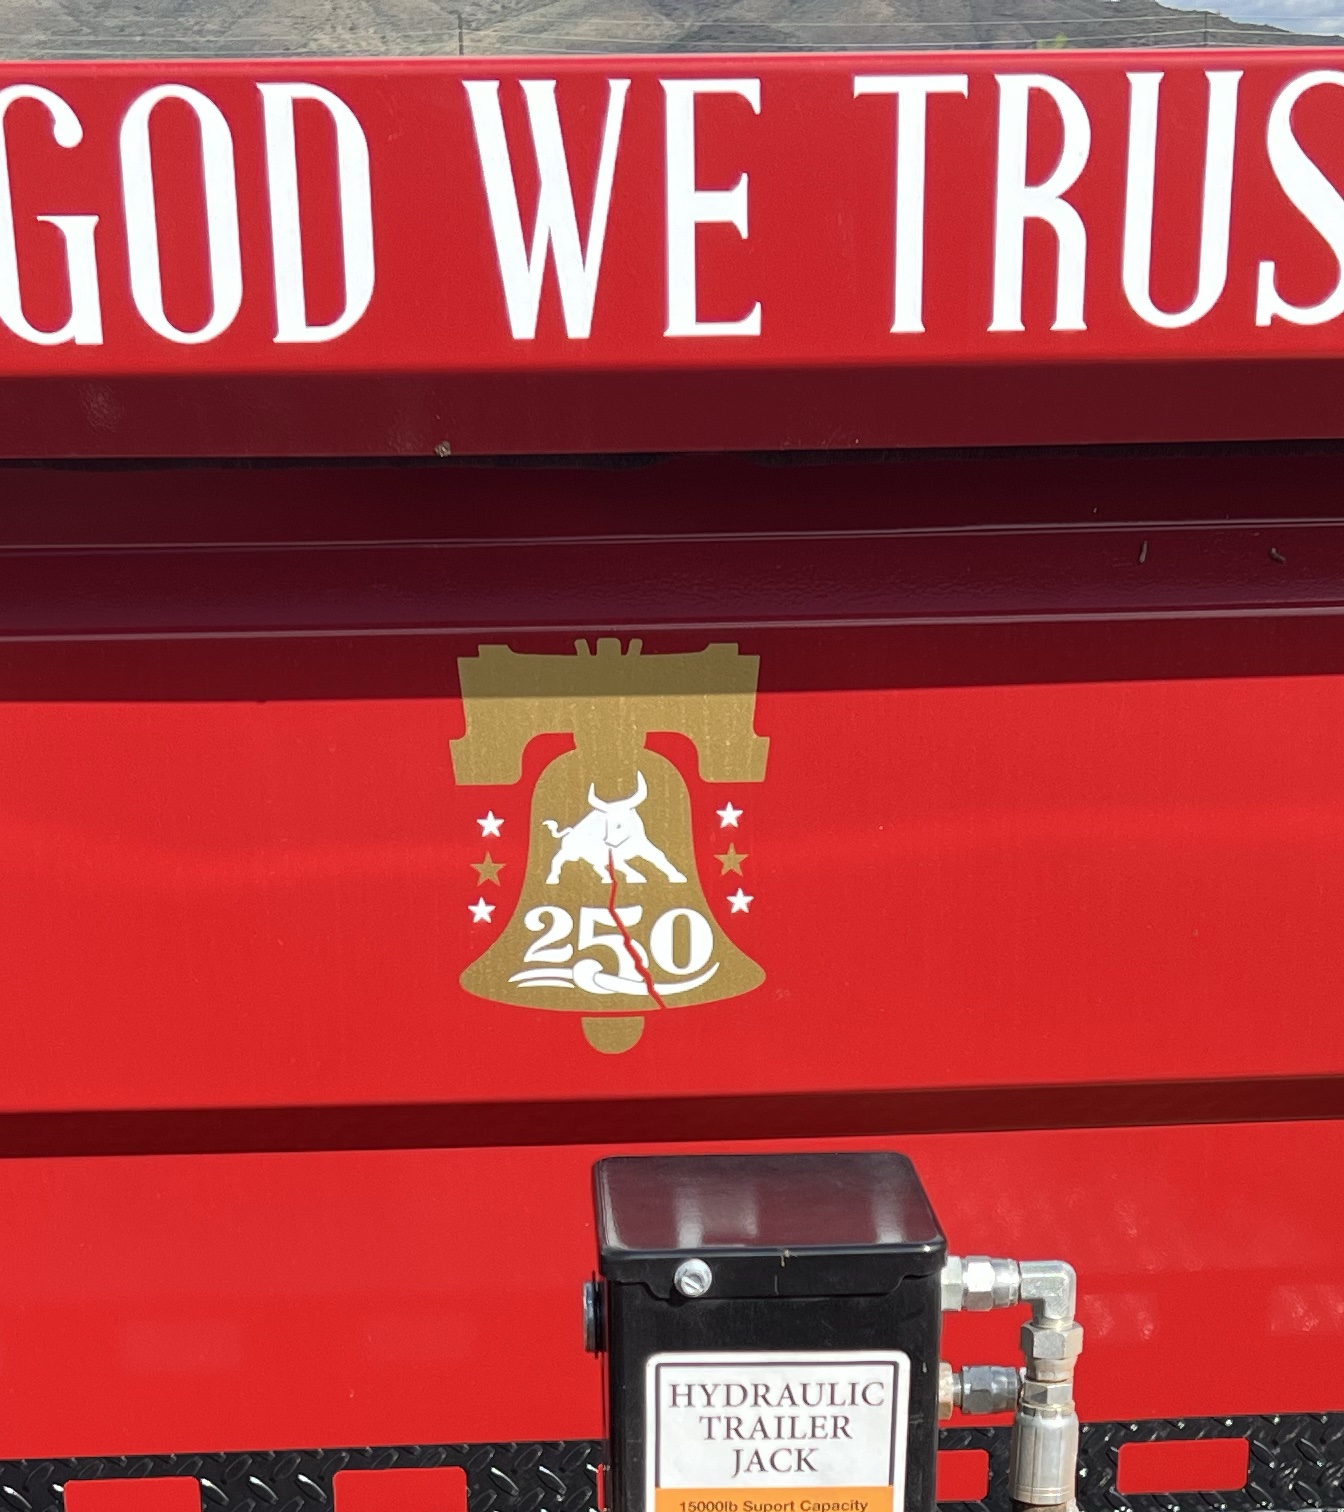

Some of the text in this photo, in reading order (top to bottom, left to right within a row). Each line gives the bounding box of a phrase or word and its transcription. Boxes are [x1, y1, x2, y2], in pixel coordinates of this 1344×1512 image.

[462, 79, 761, 339] WE
[523, 905, 714, 977] 250
[669, 1381, 885, 1408] HYDRAULIC
[699, 1415, 853, 1441] TRAILER
[730, 1448, 819, 1478] JACK
